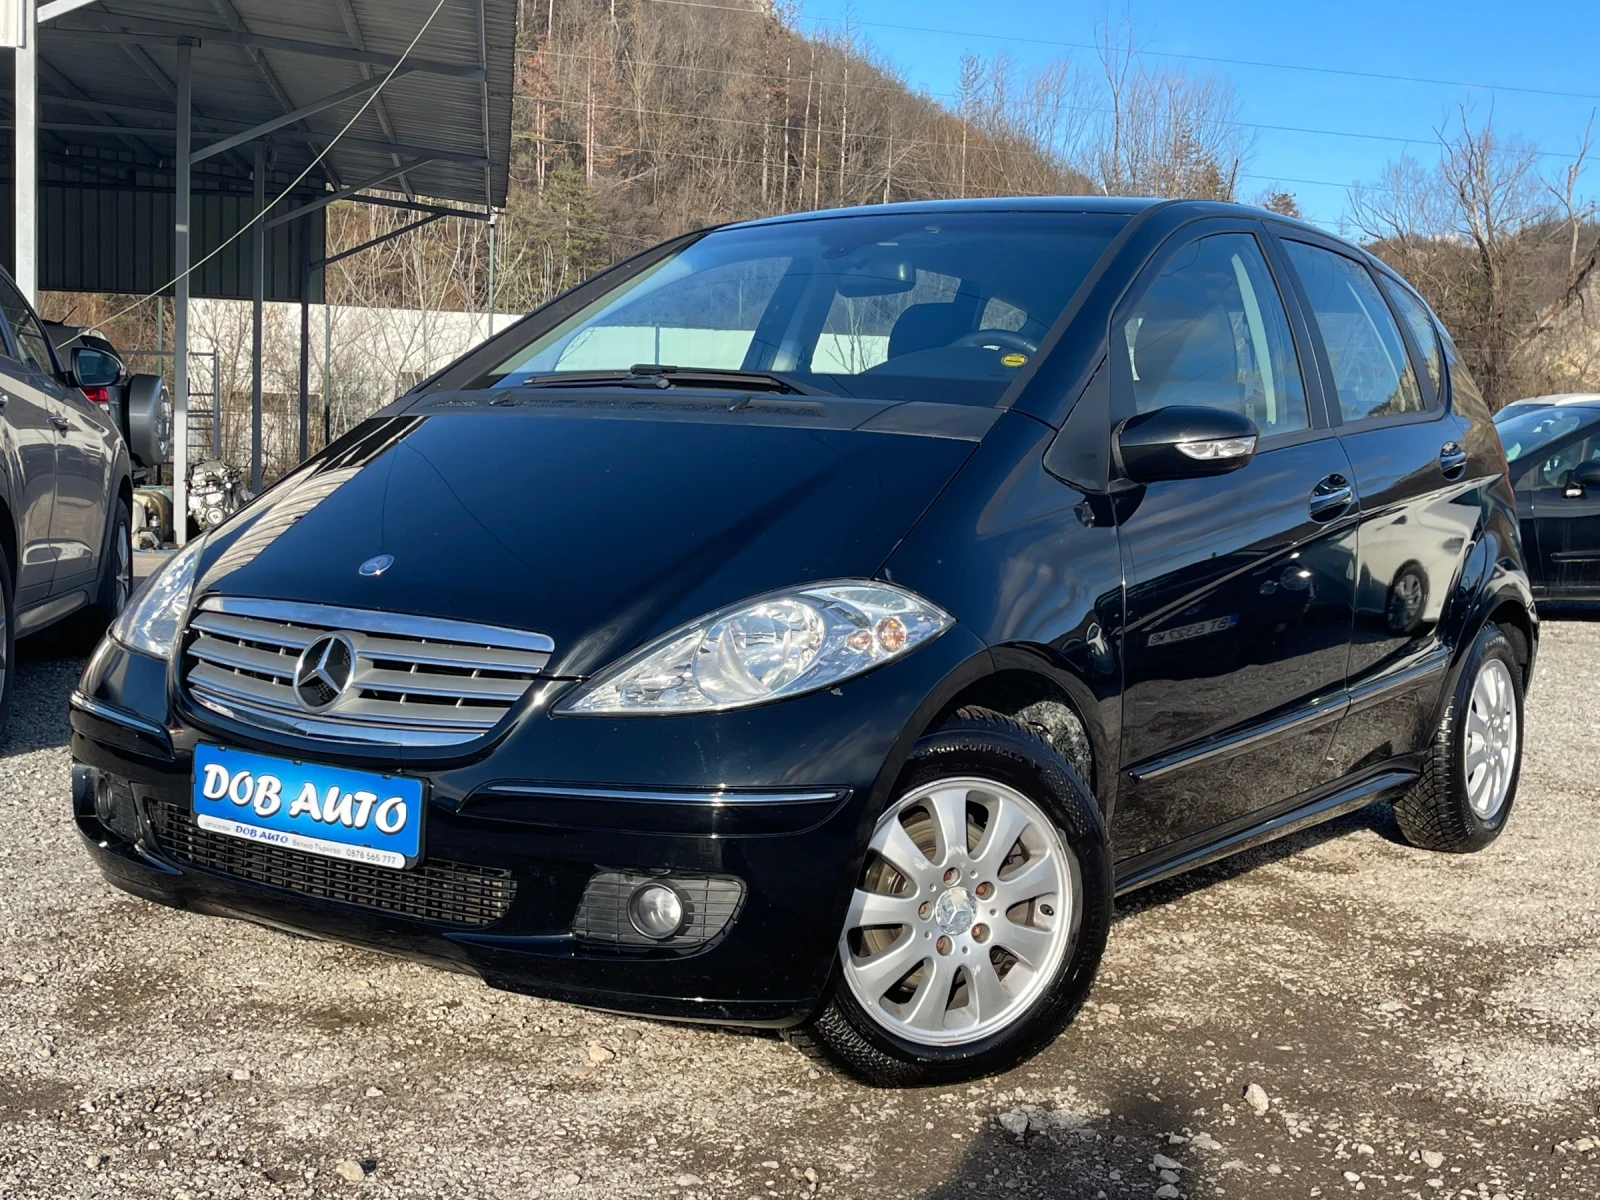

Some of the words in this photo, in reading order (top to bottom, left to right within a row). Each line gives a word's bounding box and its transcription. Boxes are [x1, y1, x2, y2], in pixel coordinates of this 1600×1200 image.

[203, 763, 282, 816] DOB
[289, 782, 407, 834] AUTO
[235, 825, 258, 838] DOB
[260, 831, 288, 844] AUTO
[346, 848, 365, 859] 0878
[367, 851, 381, 862] 565
[382, 855, 397, 865] 777
